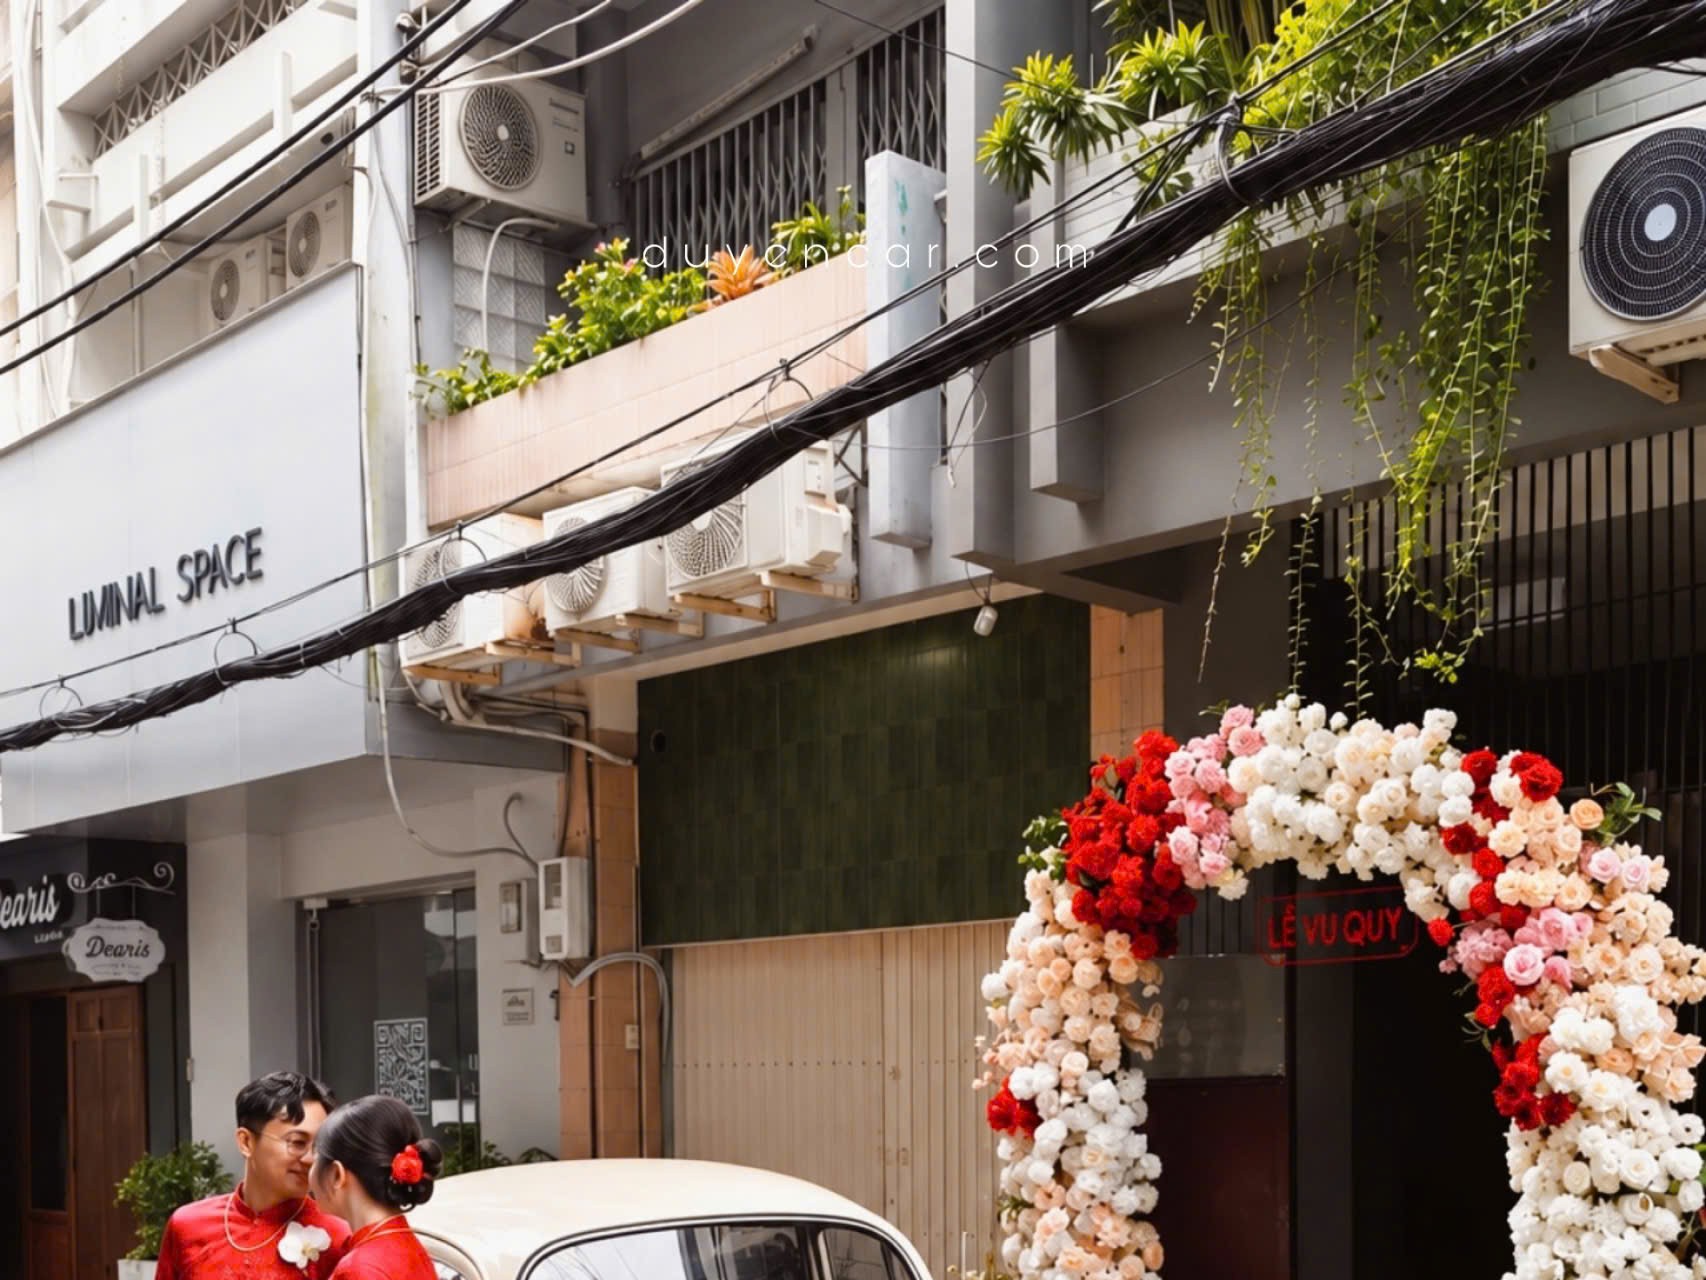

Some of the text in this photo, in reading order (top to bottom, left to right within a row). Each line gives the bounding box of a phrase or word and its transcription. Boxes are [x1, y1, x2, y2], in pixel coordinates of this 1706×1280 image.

[177, 527, 263, 604] SPACE
[0, 875, 60, 929] earis
[85, 935, 150, 958] Dearis
[1302, 912, 1337, 945] VU
[1343, 906, 1402, 946] QUY
